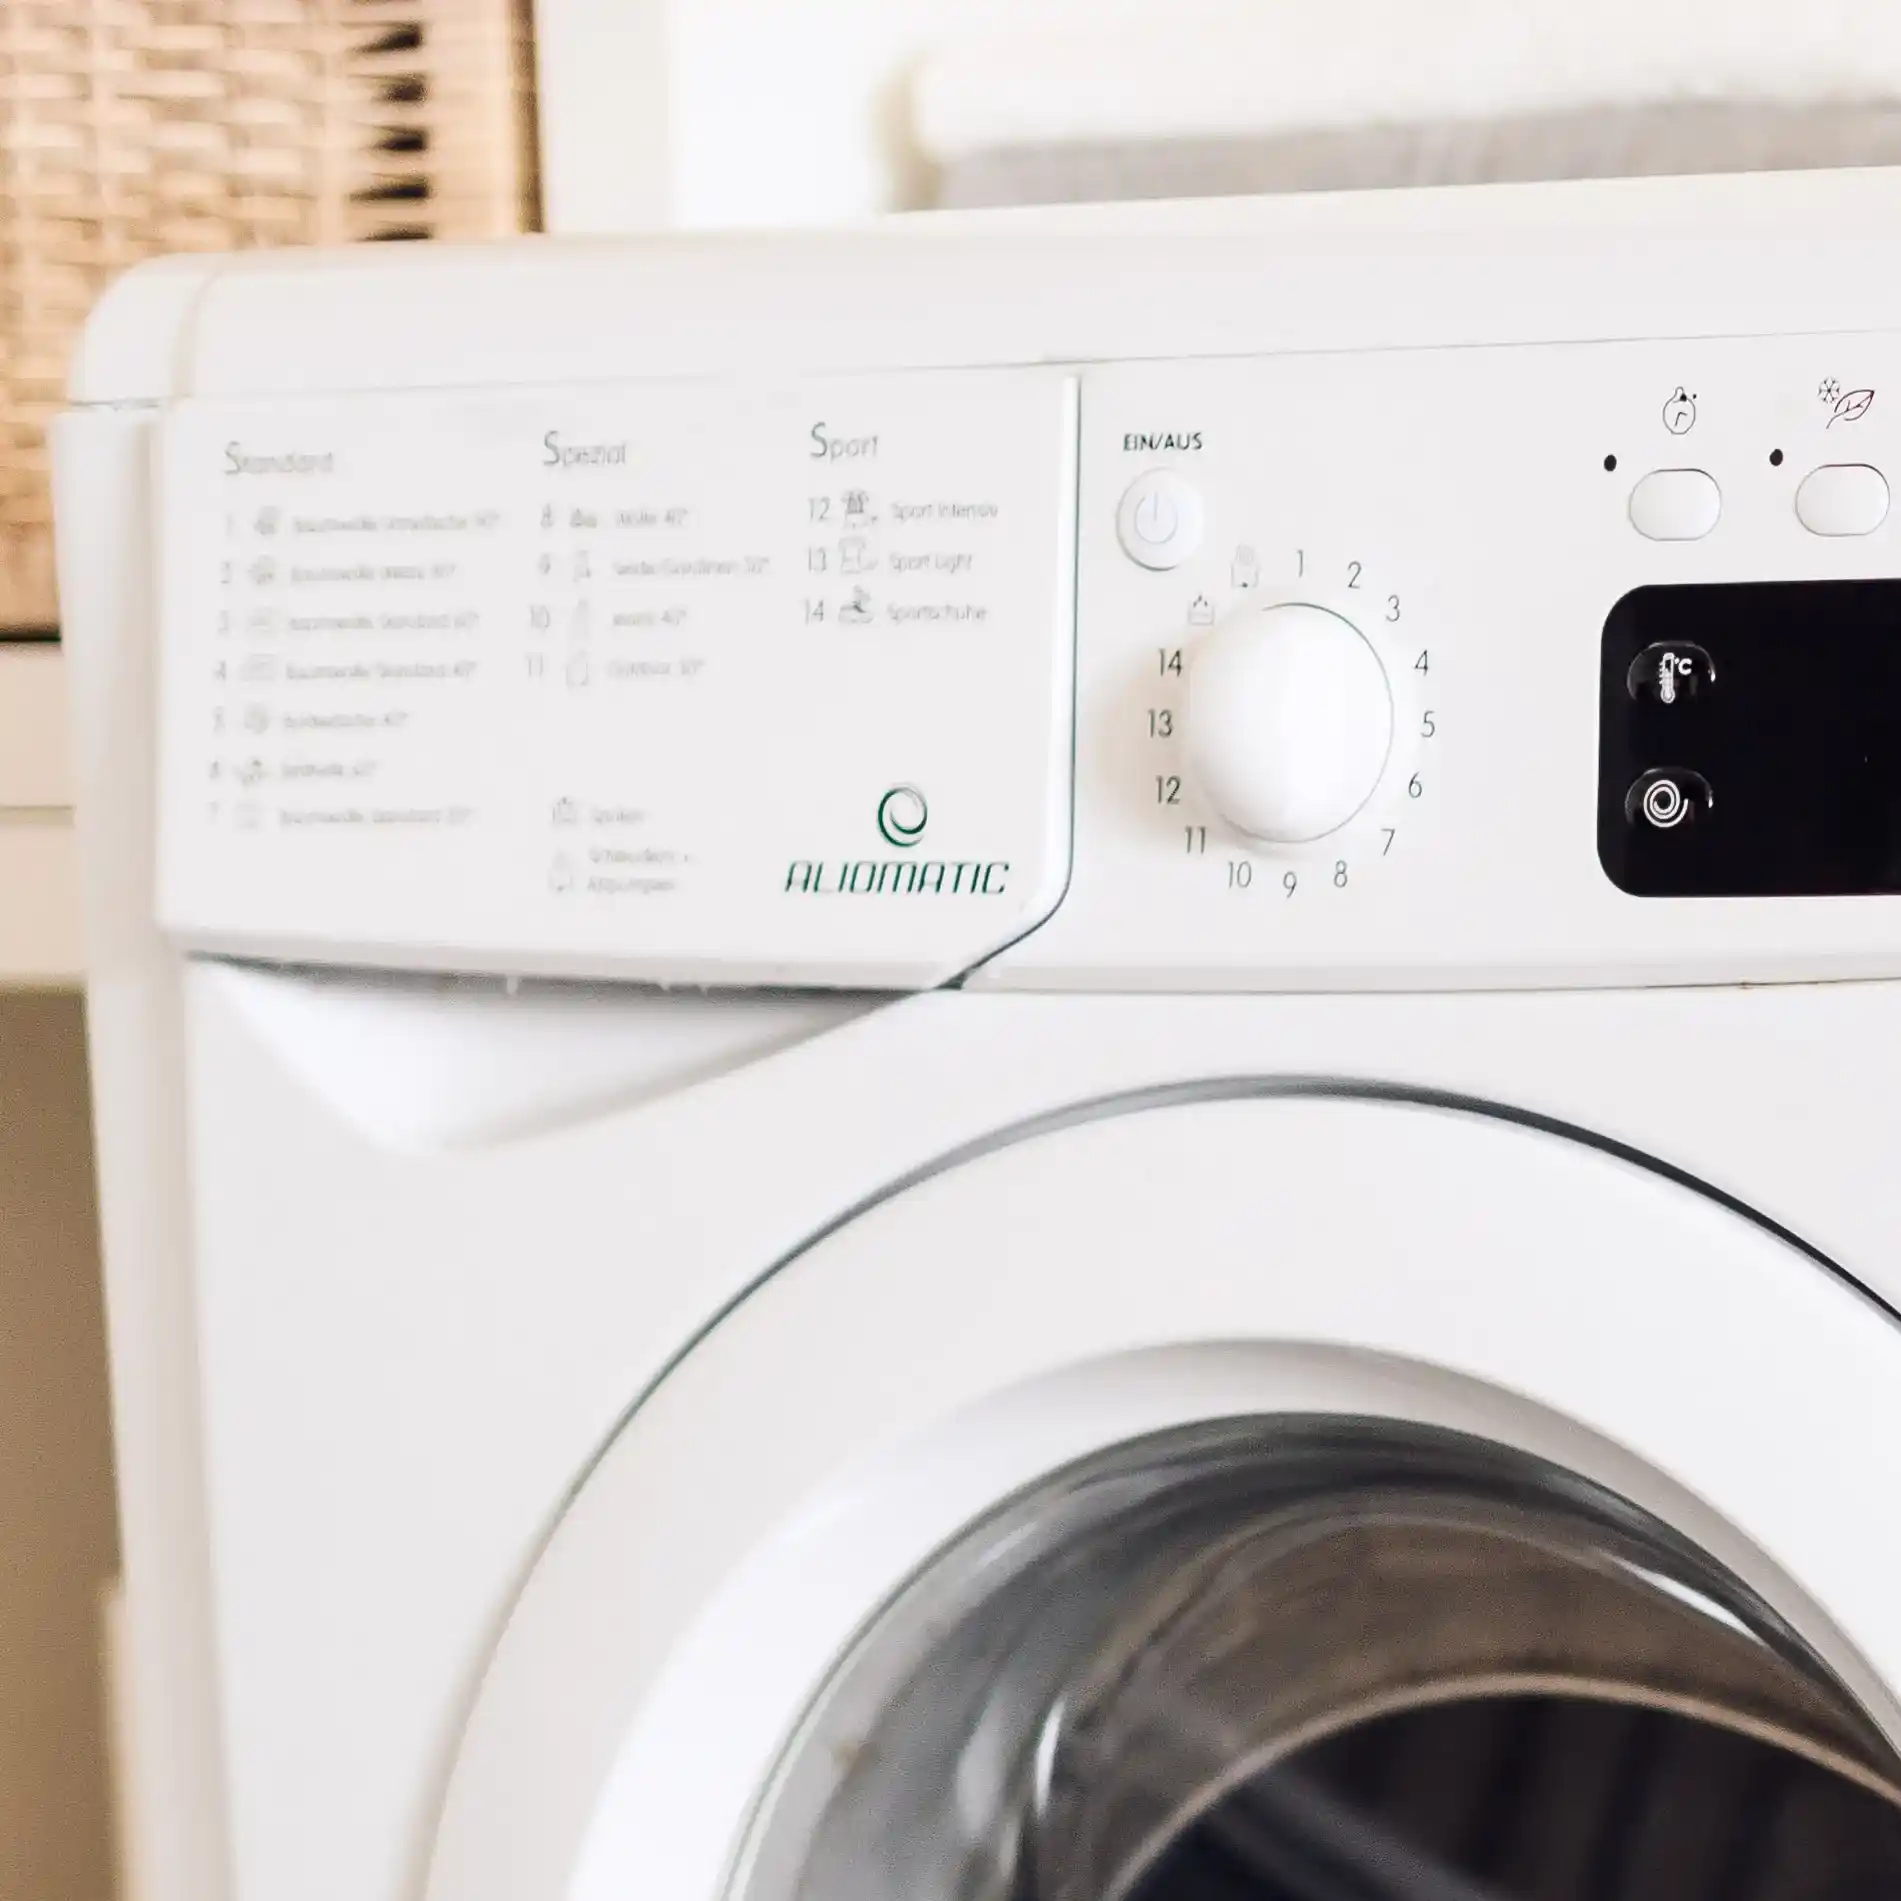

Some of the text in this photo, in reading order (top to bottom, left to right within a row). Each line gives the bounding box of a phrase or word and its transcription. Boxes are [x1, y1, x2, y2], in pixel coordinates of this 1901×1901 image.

[810, 421, 878, 465] Sport
[1124, 433, 1202, 450] EIN/AUS
[810, 497, 830, 521] 12
[808, 547, 827, 572] 13
[1298, 550, 1303, 577] 1
[1348, 561, 1361, 588] 2
[806, 600, 824, 621] 14
[1387, 595, 1400, 622] 3
[1161, 650, 1182, 676] 14
[1415, 650, 1428, 674] 4
[1149, 710, 1173, 737] 13
[1422, 711, 1435, 737] 5
[1157, 776, 1180, 804] 12
[1409, 773, 1422, 797] 6
[1185, 825, 1208, 853] 11
[1383, 829, 1395, 856] 7
[785, 863, 1009, 893] ALIOMATIC
[1229, 861, 1251, 888] 10
[1283, 872, 1296, 897] 9
[1334, 860, 1347, 888] 8
